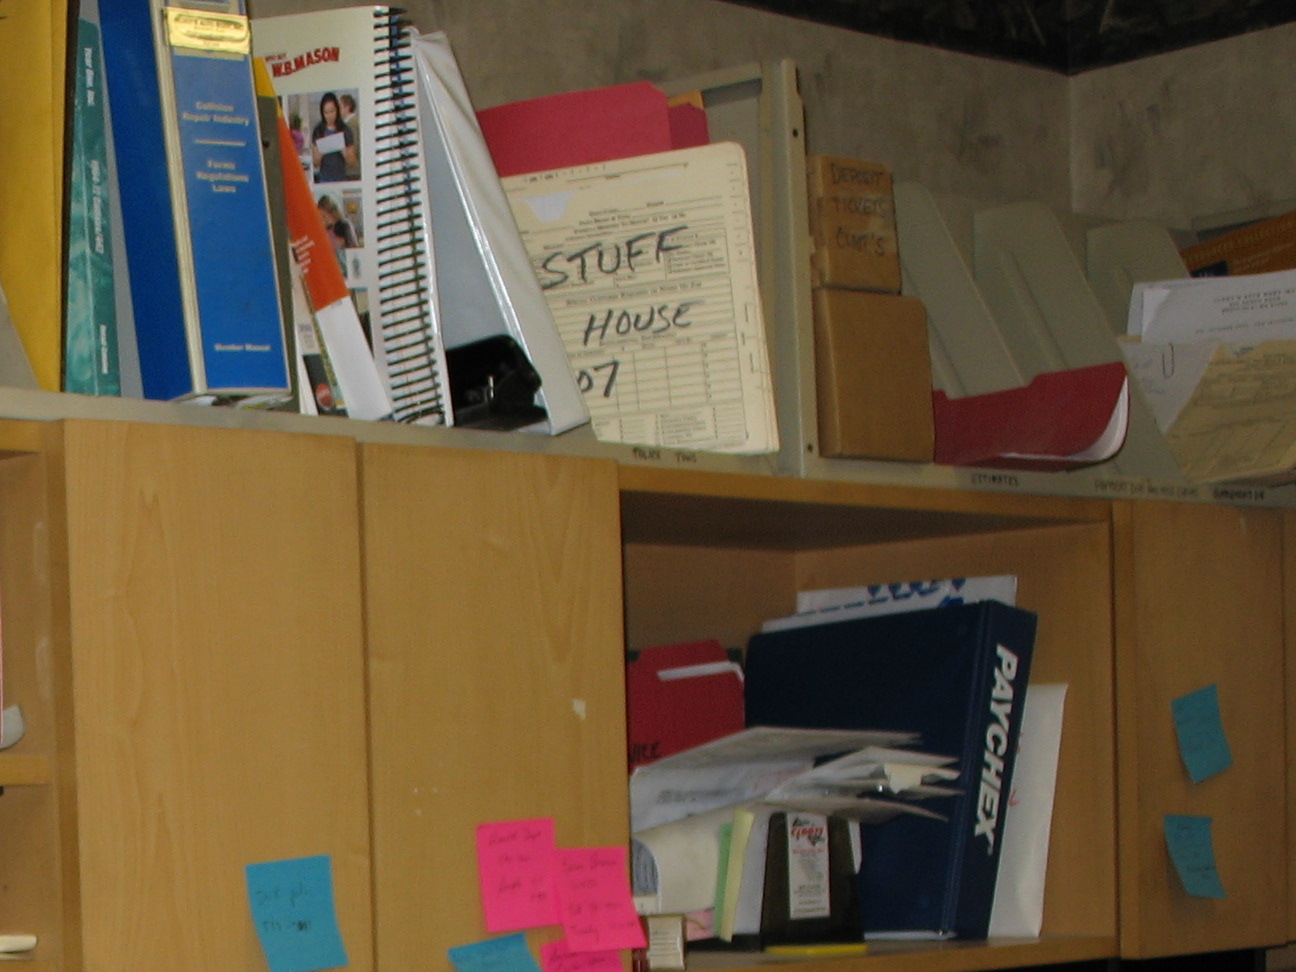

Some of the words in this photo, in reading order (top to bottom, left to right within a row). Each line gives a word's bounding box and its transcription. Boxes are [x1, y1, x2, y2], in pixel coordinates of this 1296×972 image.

[542, 226, 689, 290] STUFF
[584, 301, 699, 346] HOUSE
[975, 642, 1019, 846] PAYCHEX
